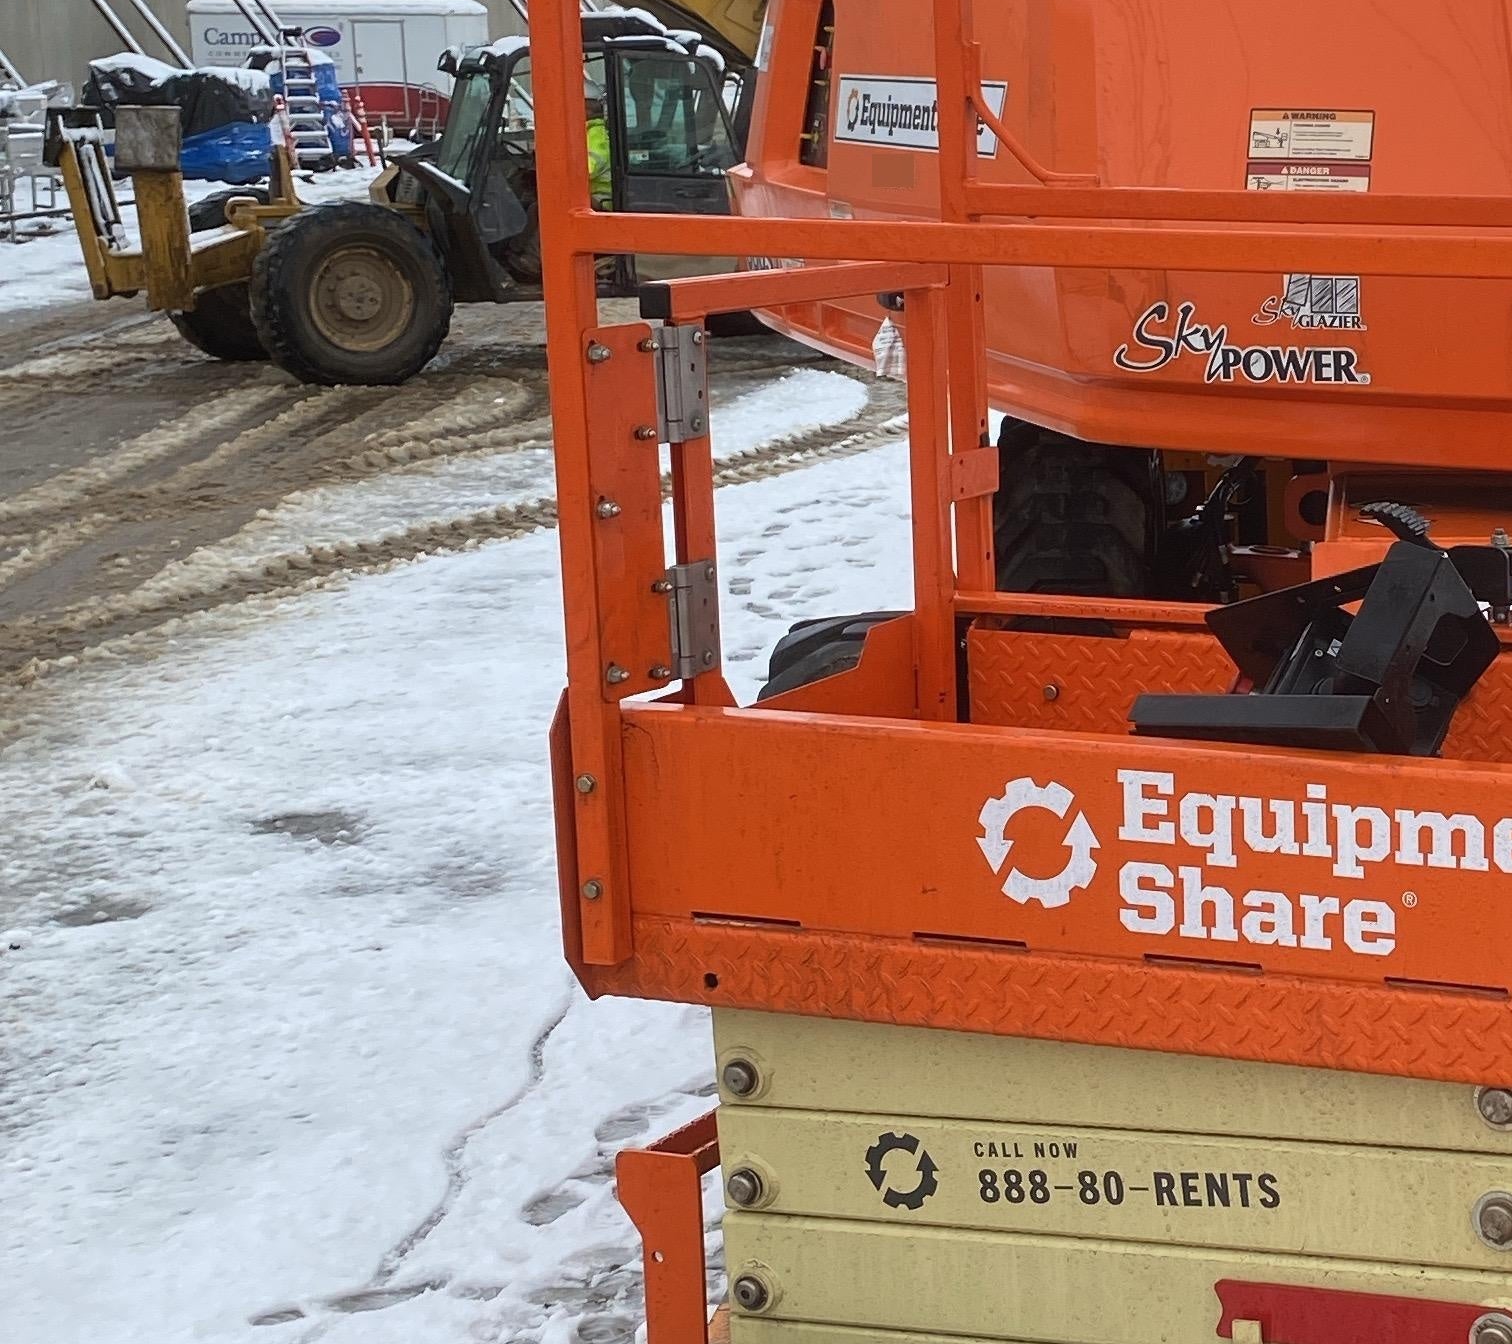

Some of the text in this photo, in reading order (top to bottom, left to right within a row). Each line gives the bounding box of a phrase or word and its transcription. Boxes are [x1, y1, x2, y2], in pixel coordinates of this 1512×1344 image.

[1290, 112, 1337, 121] WARNING
[1289, 166, 1330, 175] DANGER
[1251, 296, 1363, 330] Sky GLAZIER
[1114, 303, 1359, 383] Sky POWER
[1116, 859, 1398, 957] Share
[973, 1141, 1079, 1159] CALL NOW
[977, 1168, 1282, 1209] 888-80-RENTS
